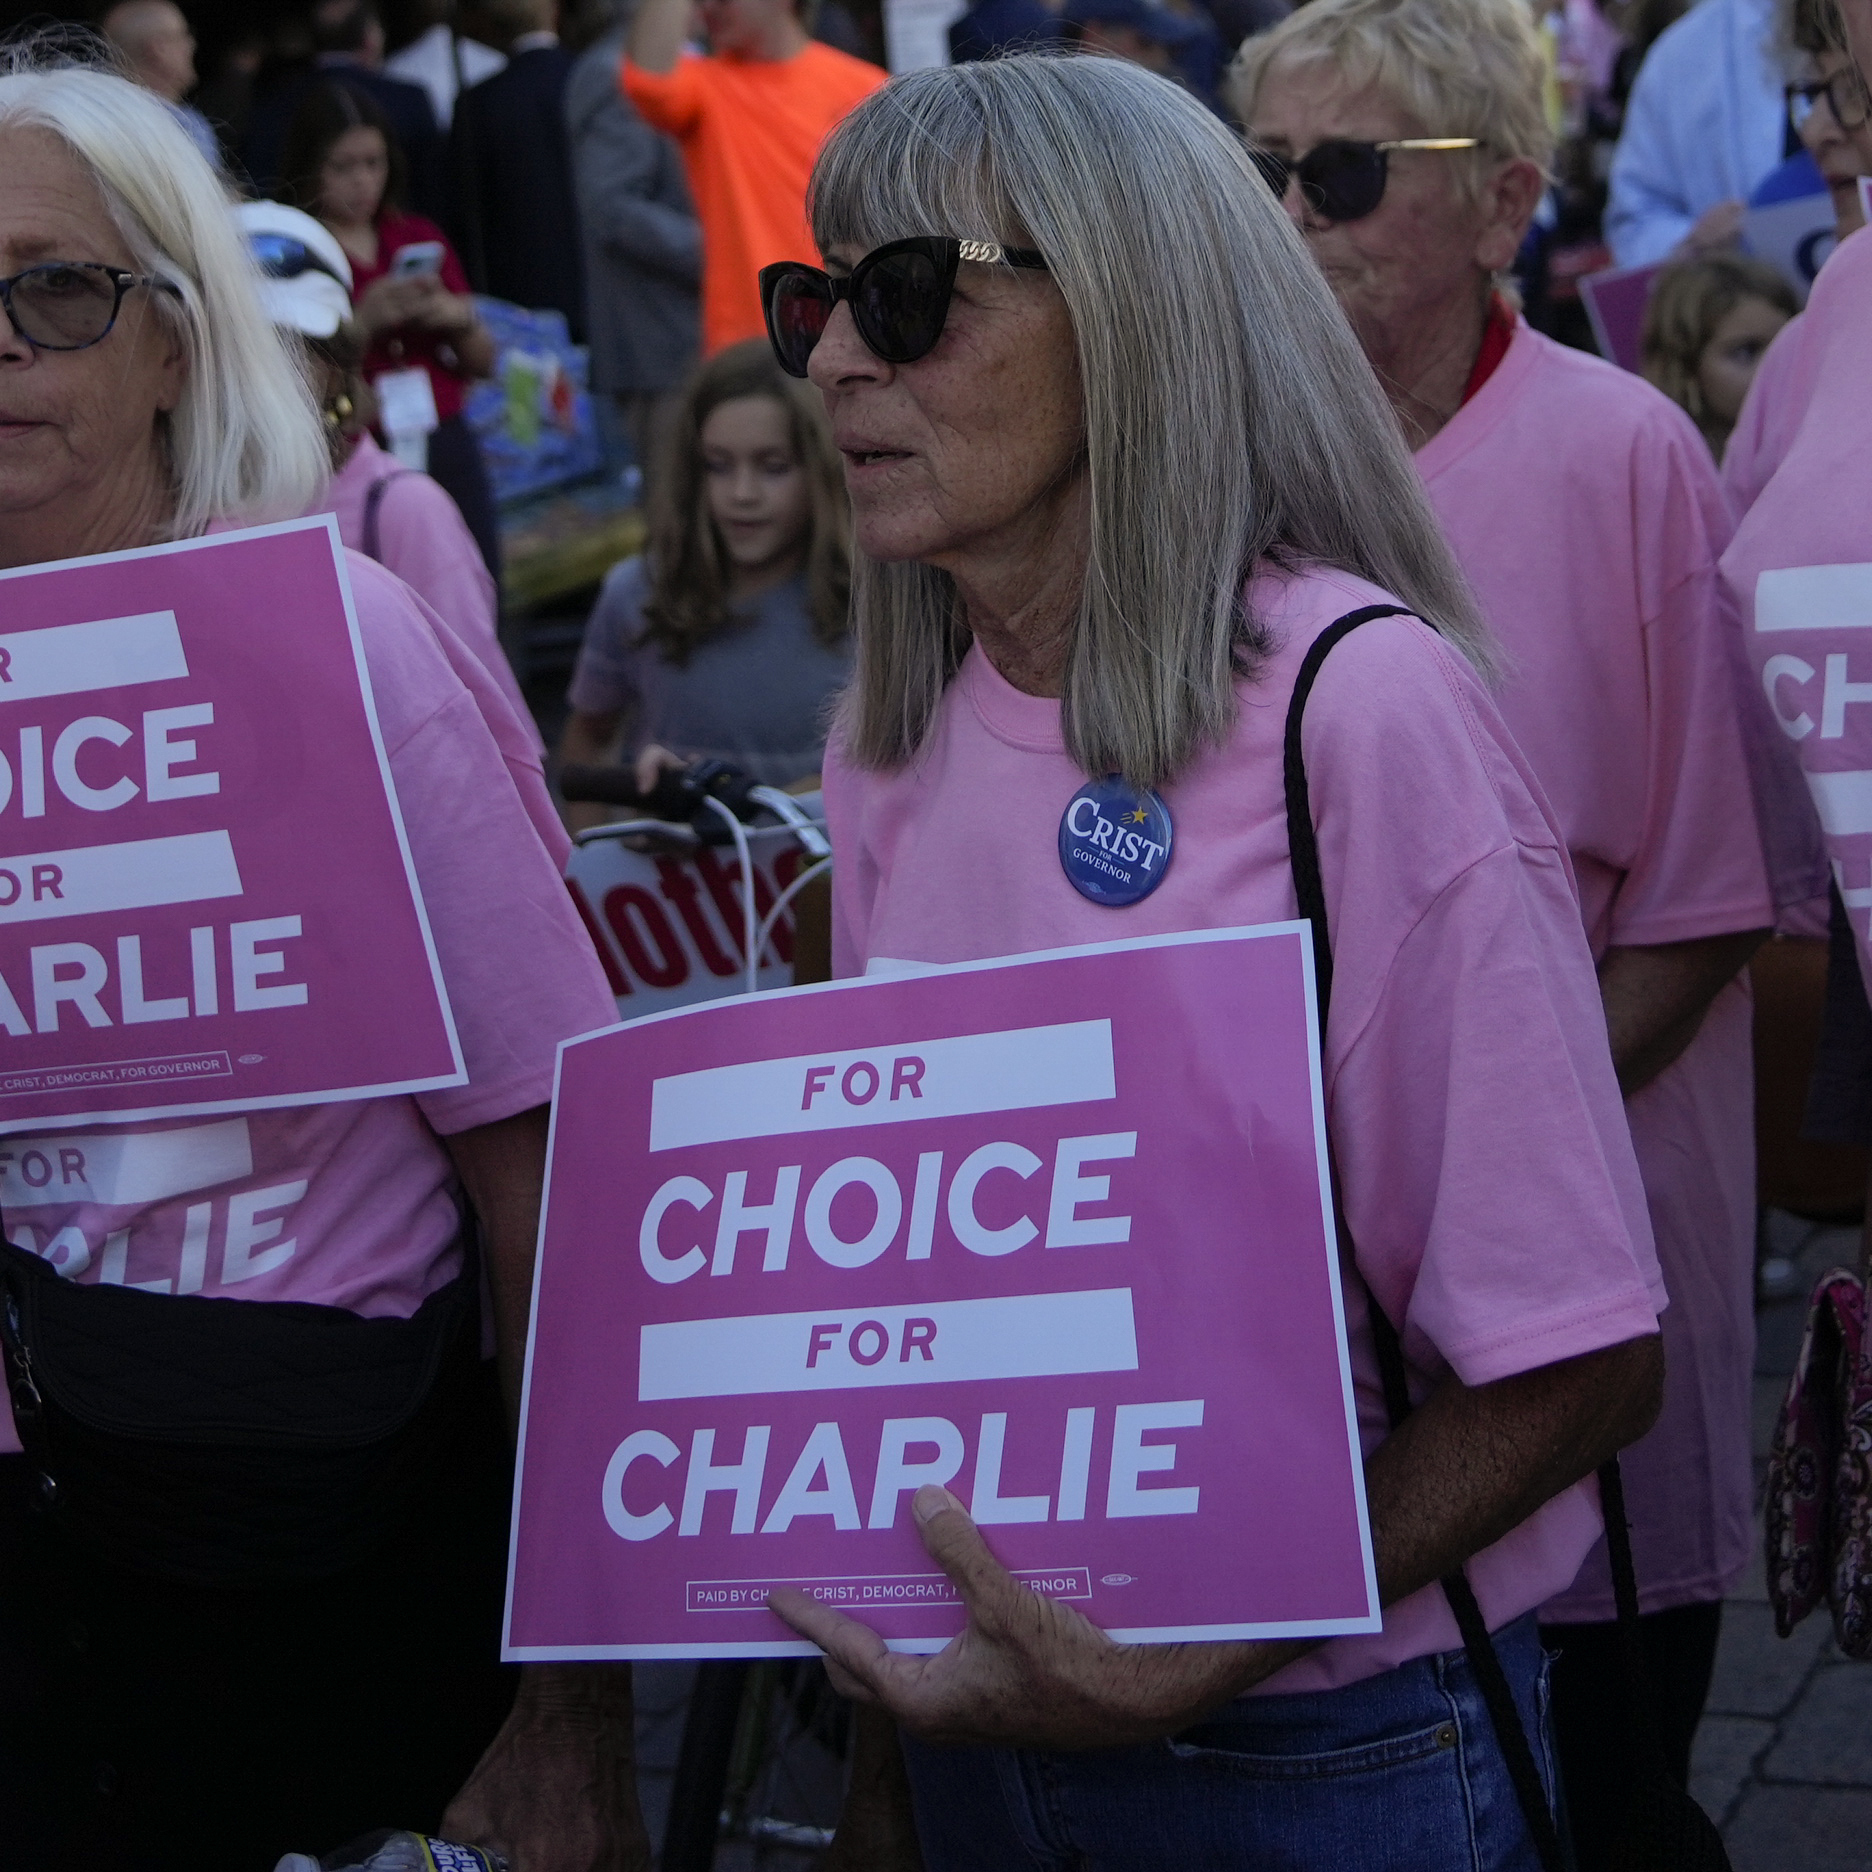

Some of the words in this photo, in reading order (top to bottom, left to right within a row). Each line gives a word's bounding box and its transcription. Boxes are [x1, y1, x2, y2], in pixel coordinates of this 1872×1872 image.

[1067, 797, 1165, 871] CRIST
[1098, 849, 1113, 862] FOR
[1073, 847, 1132, 884] GOVERNOR
[5, 1075, 46, 1091] CRIST,
[46, 1068, 120, 1086] DEMOCRAT,
[121, 1065, 148, 1078] FOR
[148, 1058, 221, 1076] GOVERNOR
[800, 1055, 926, 1111] FOR
[638, 1131, 1138, 1284] CHOICE
[804, 1316, 938, 1370] FOR
[602, 1399, 1205, 1542] CHARLIE
[696, 1589, 728, 1604] PAID
[730, 1590, 749, 1603] BY
[813, 1585, 861, 1602] CRIST,
[862, 1583, 951, 1601] DEMOCRAT,
